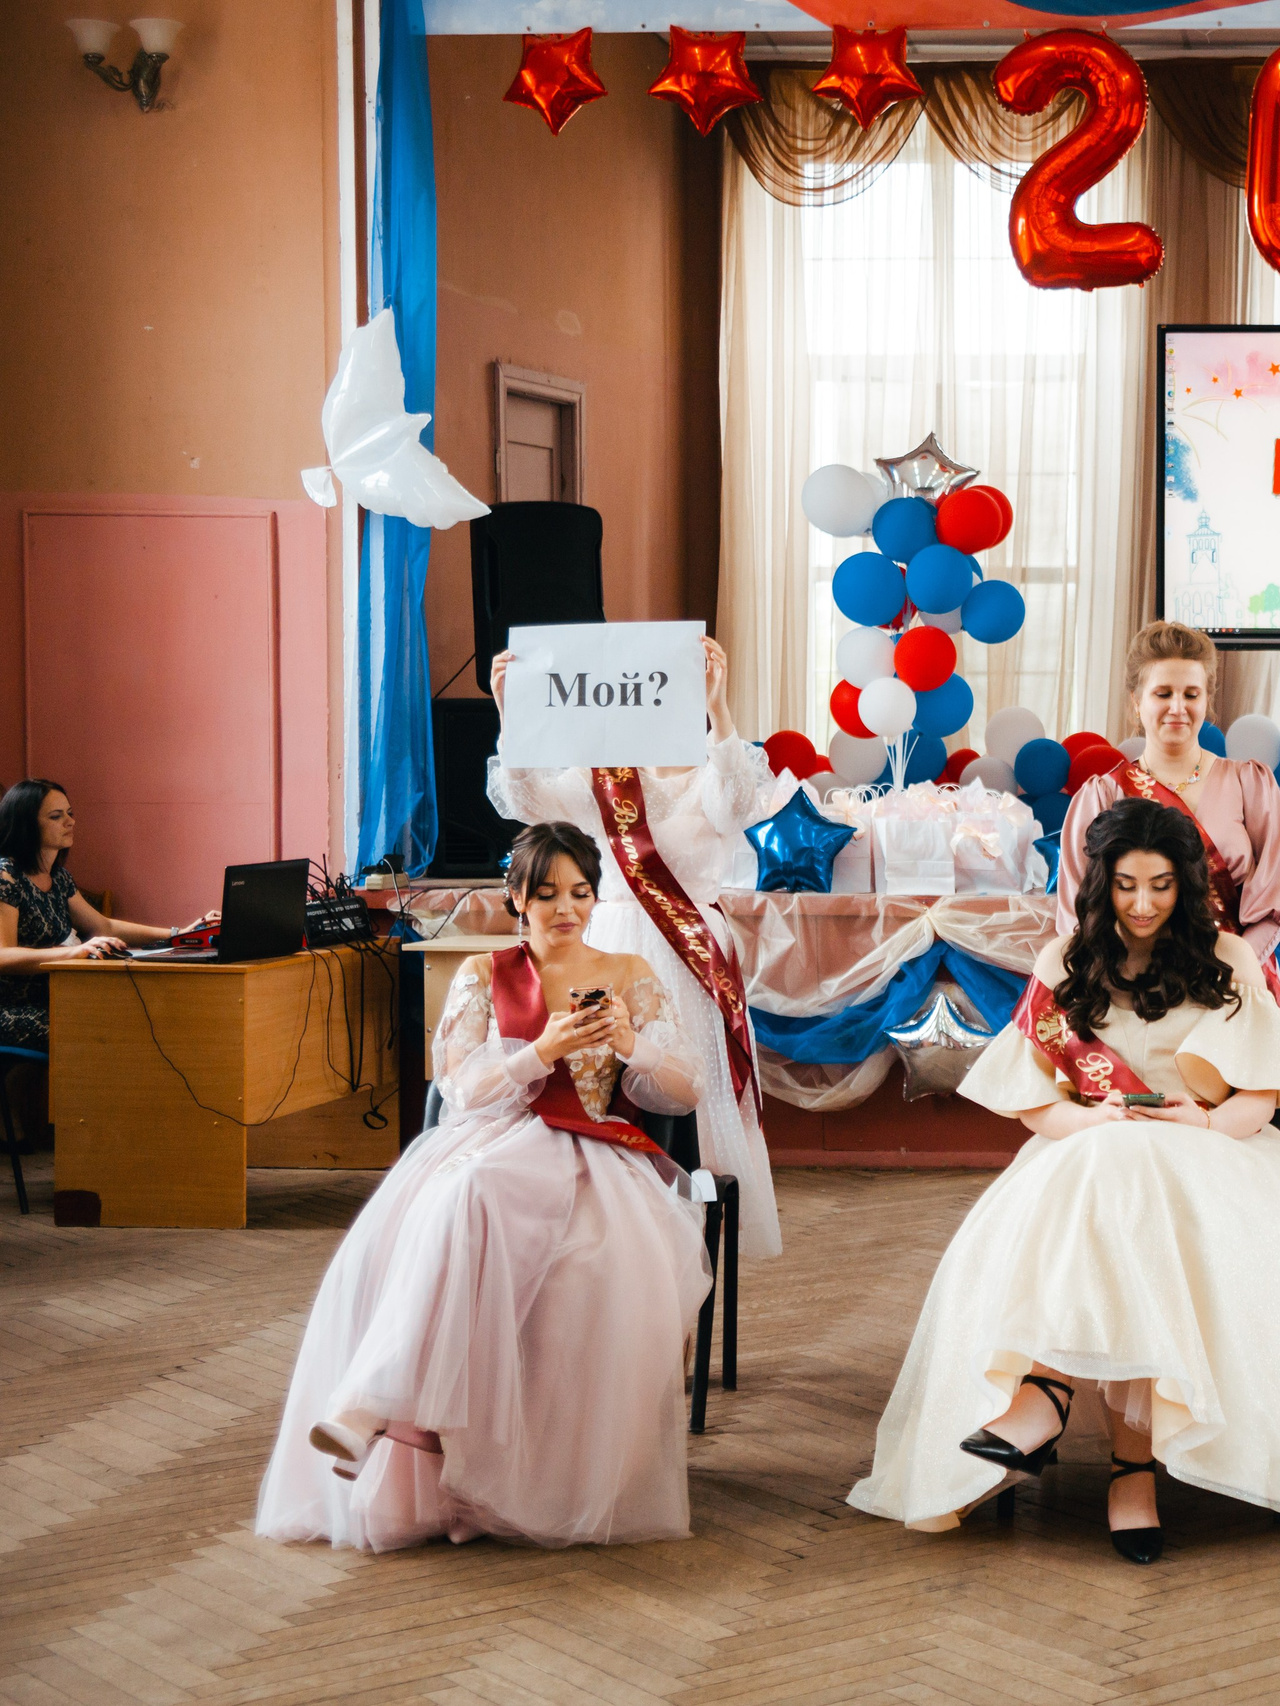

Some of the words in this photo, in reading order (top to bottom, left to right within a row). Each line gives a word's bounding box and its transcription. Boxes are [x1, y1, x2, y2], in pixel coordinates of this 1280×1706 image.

[544, 671, 669, 708] Мой?
[611, 797, 711, 963] Выпускница
[711, 966, 743, 1014] 2023
